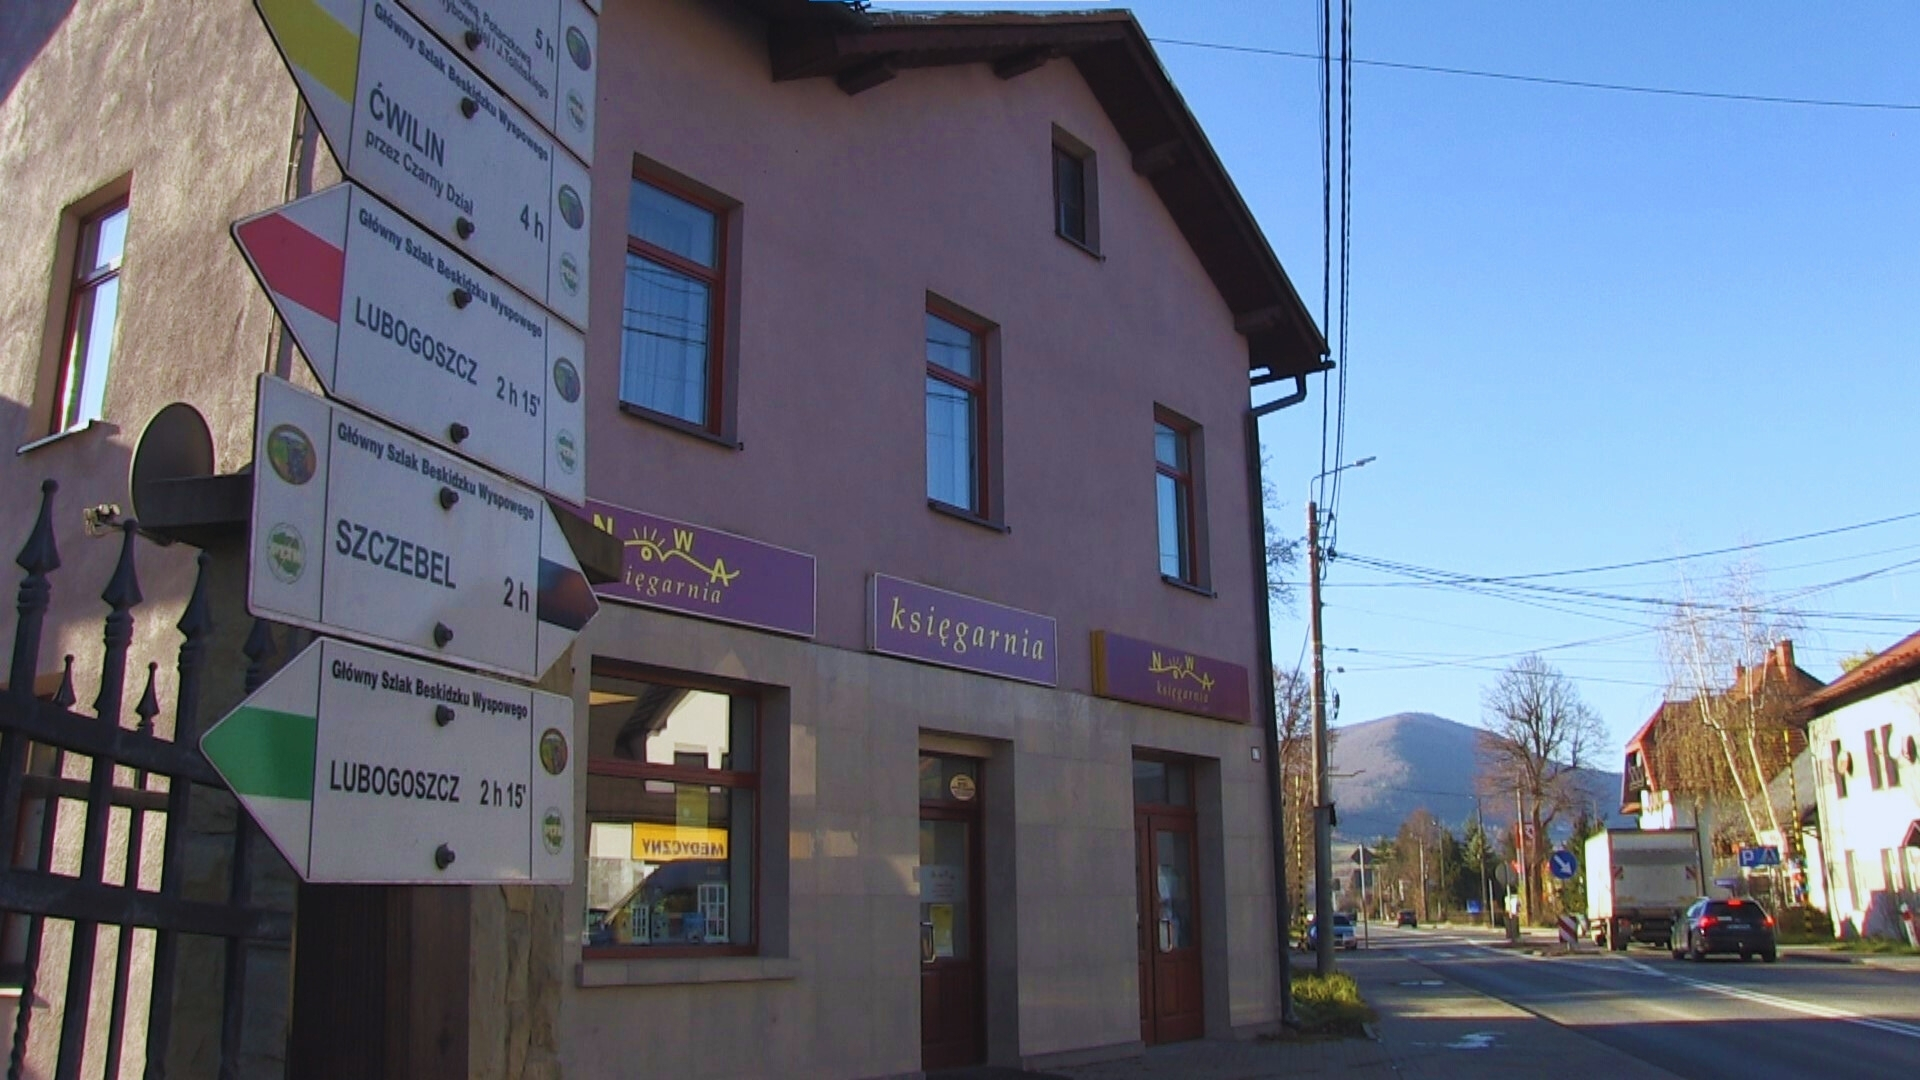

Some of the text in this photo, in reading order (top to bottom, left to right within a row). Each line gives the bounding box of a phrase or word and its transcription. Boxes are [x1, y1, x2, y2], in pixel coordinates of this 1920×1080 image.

[535, 27, 554, 63] 5 h
[374, 2, 416, 50] Główny
[418, 39, 446, 75] Szlak
[448, 64, 497, 118] Beskidzku
[498, 107, 548, 162] Wyspowego
[369, 81, 445, 168] ĆWILIN
[365, 129, 400, 166] przez
[402, 152, 444, 198] Czarny
[519, 203, 544, 243] 4 h
[358, 207, 542, 338] Główny Szlak Beskidzku Wyspowego
[355, 295, 477, 386] LUBOGOSZCZ
[496, 375, 541, 418] 2 h 15'
[337, 421, 535, 522] Główny Szlak Beskidzku Wyspowego
[335, 517, 457, 590] SZCZEBEL
[624, 564, 723, 605] ięgarnia
[503, 575, 530, 613] 2 h
[890, 596, 1044, 661] księgarnia
[331, 659, 529, 721] Główny Szlak Beskidzku Wyspowego
[330, 759, 527, 810] LUBOGOSZCZ 2 h 15'
